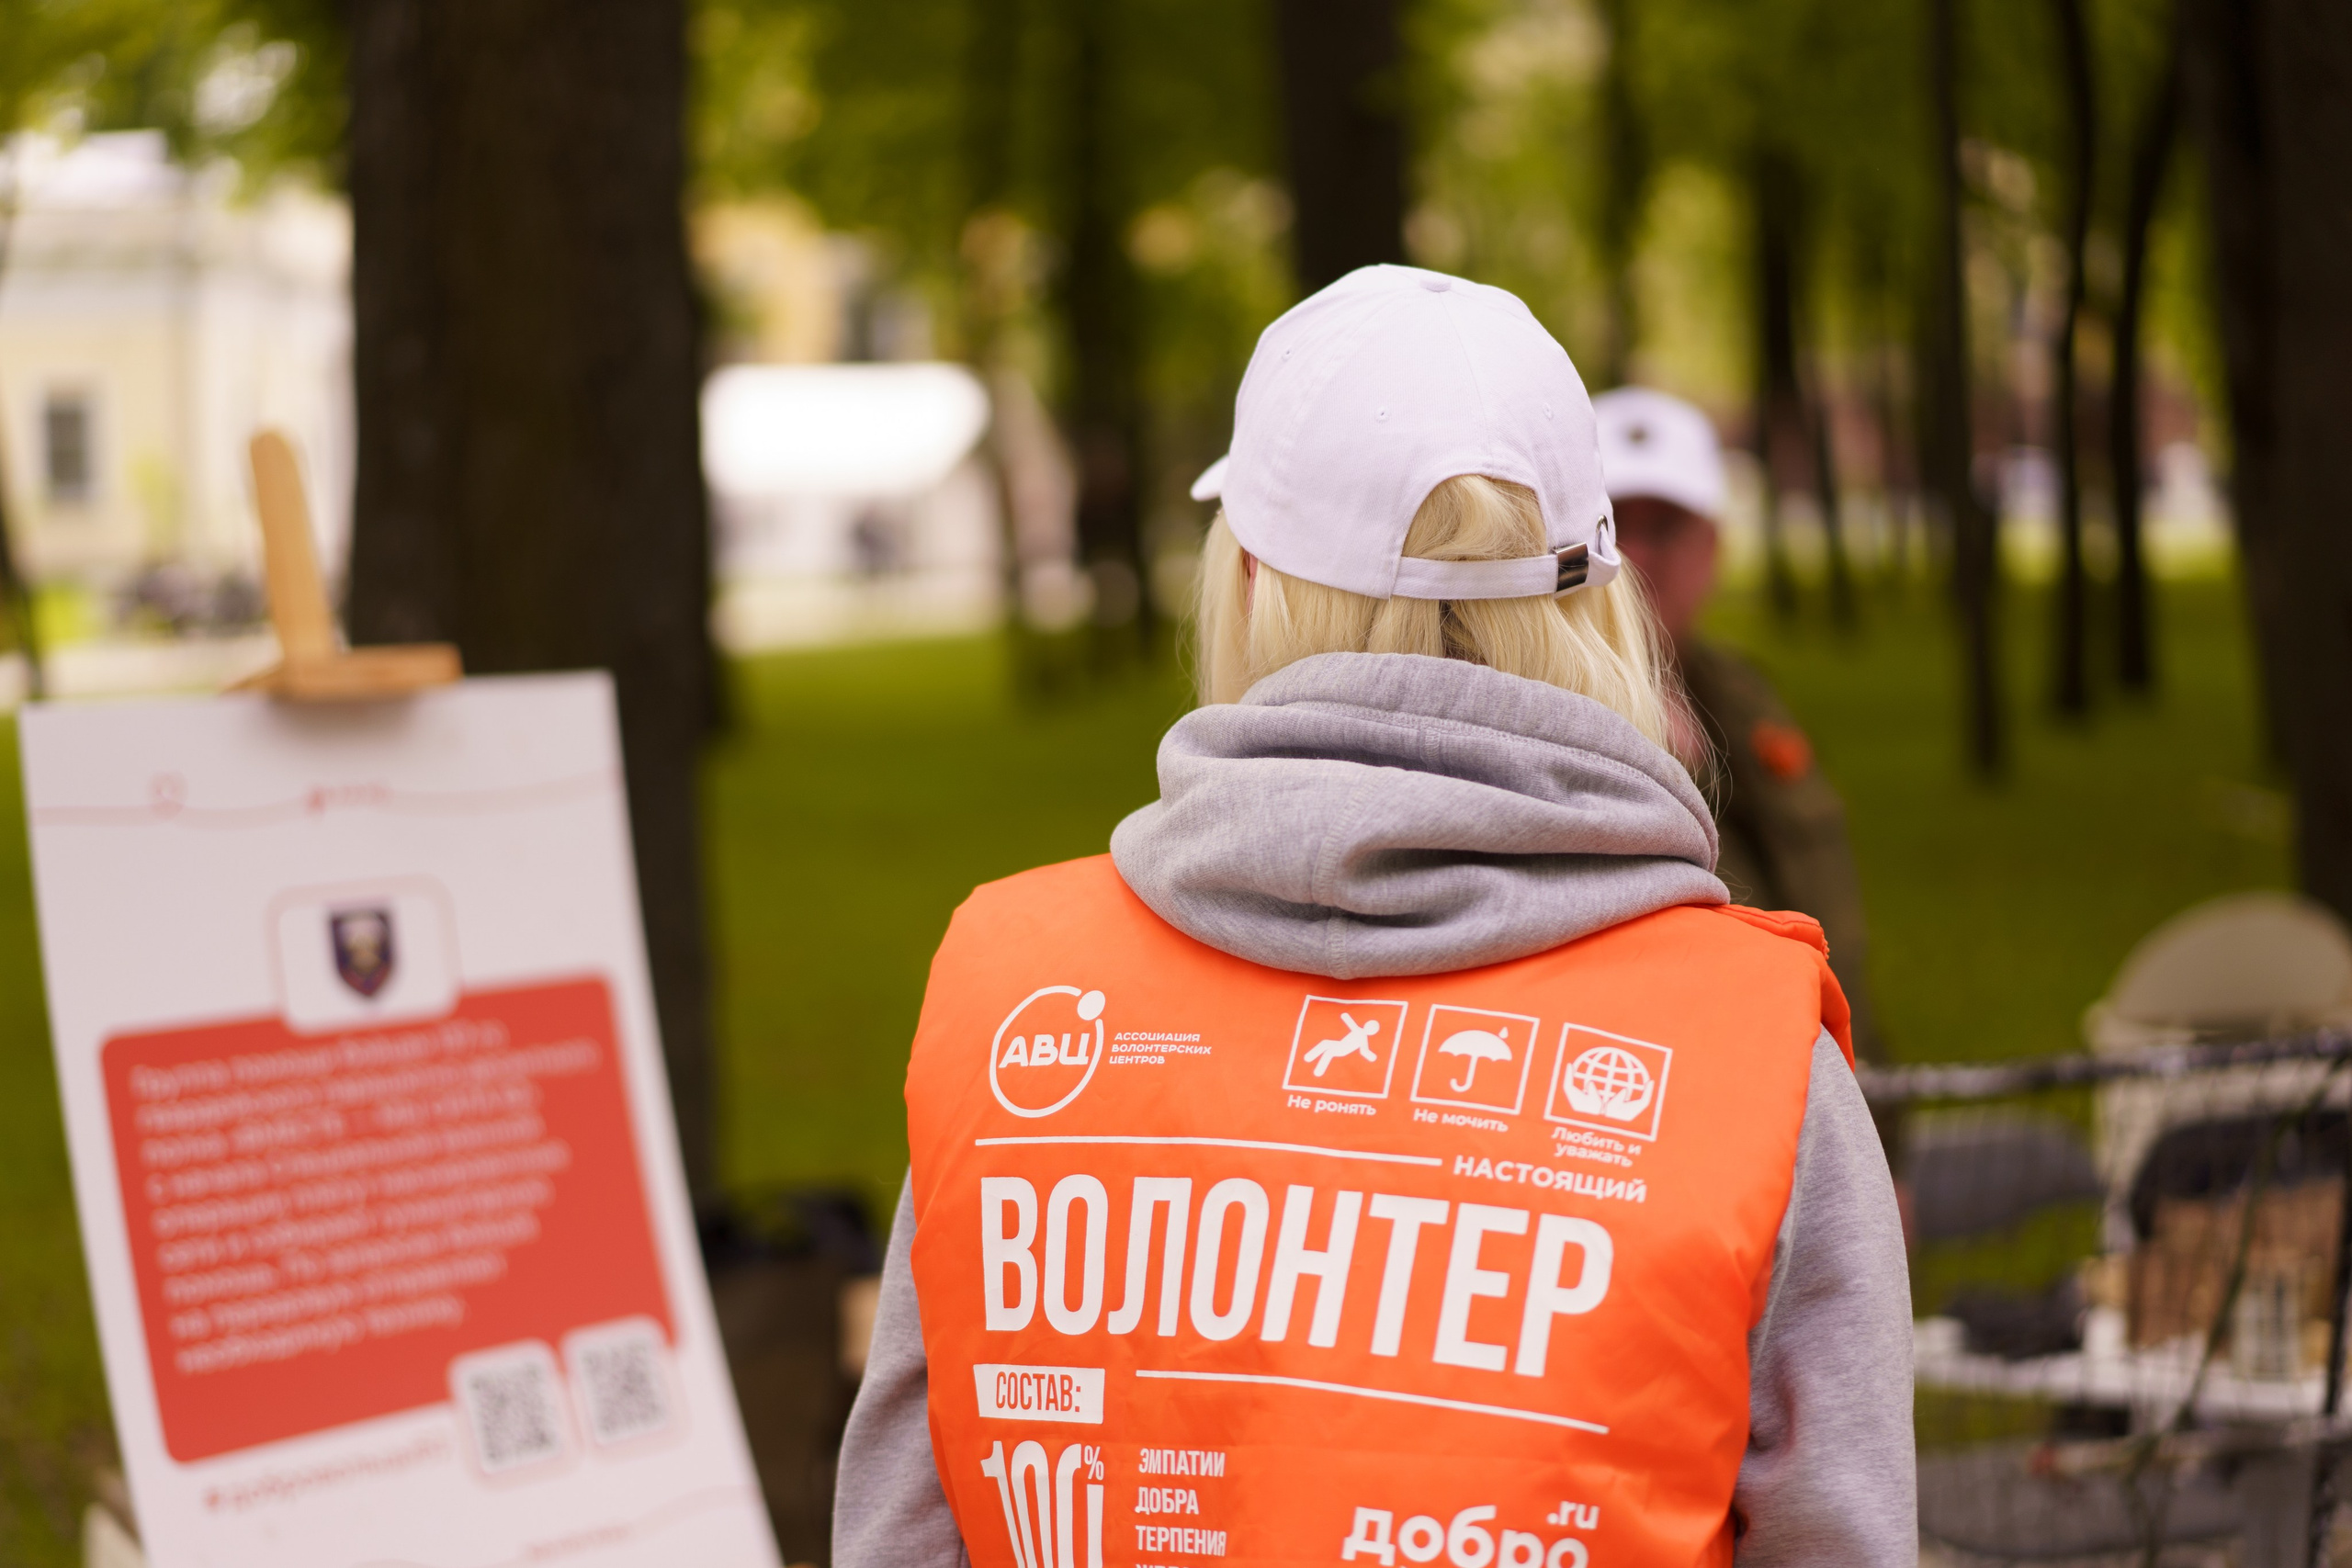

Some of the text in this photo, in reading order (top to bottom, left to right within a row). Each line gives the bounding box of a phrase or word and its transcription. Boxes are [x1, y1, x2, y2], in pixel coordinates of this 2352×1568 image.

[998, 1033, 1091, 1068] АВЦ
[1111, 1043, 1212, 1055] ВОЛОНТЕРСКИХ
[1114, 1032, 1201, 1043] АССОЦИАЦИЯ
[1109, 1055, 1165, 1065] ЦЕНТРОВ
[1287, 1094, 1377, 1116] Не ронять
[1413, 1108, 1509, 1133] Не мочить
[1551, 1126, 1642, 1156] Любить и
[1553, 1143, 1633, 1168] уважать
[1453, 1155, 1647, 1203] НАСТОЯЩИЙ
[980, 1173, 1614, 1377] ВОЛОНТЕР
[995, 1371, 1081, 1413] СОСТАВ:
[1138, 1448, 1226, 1477] ЭМПАТИИ
[1135, 1486, 1200, 1516] ДОБРА
[1136, 1525, 1227, 1557] ТЕРПЕНИЯ
[1341, 1504, 1589, 1568] добро
